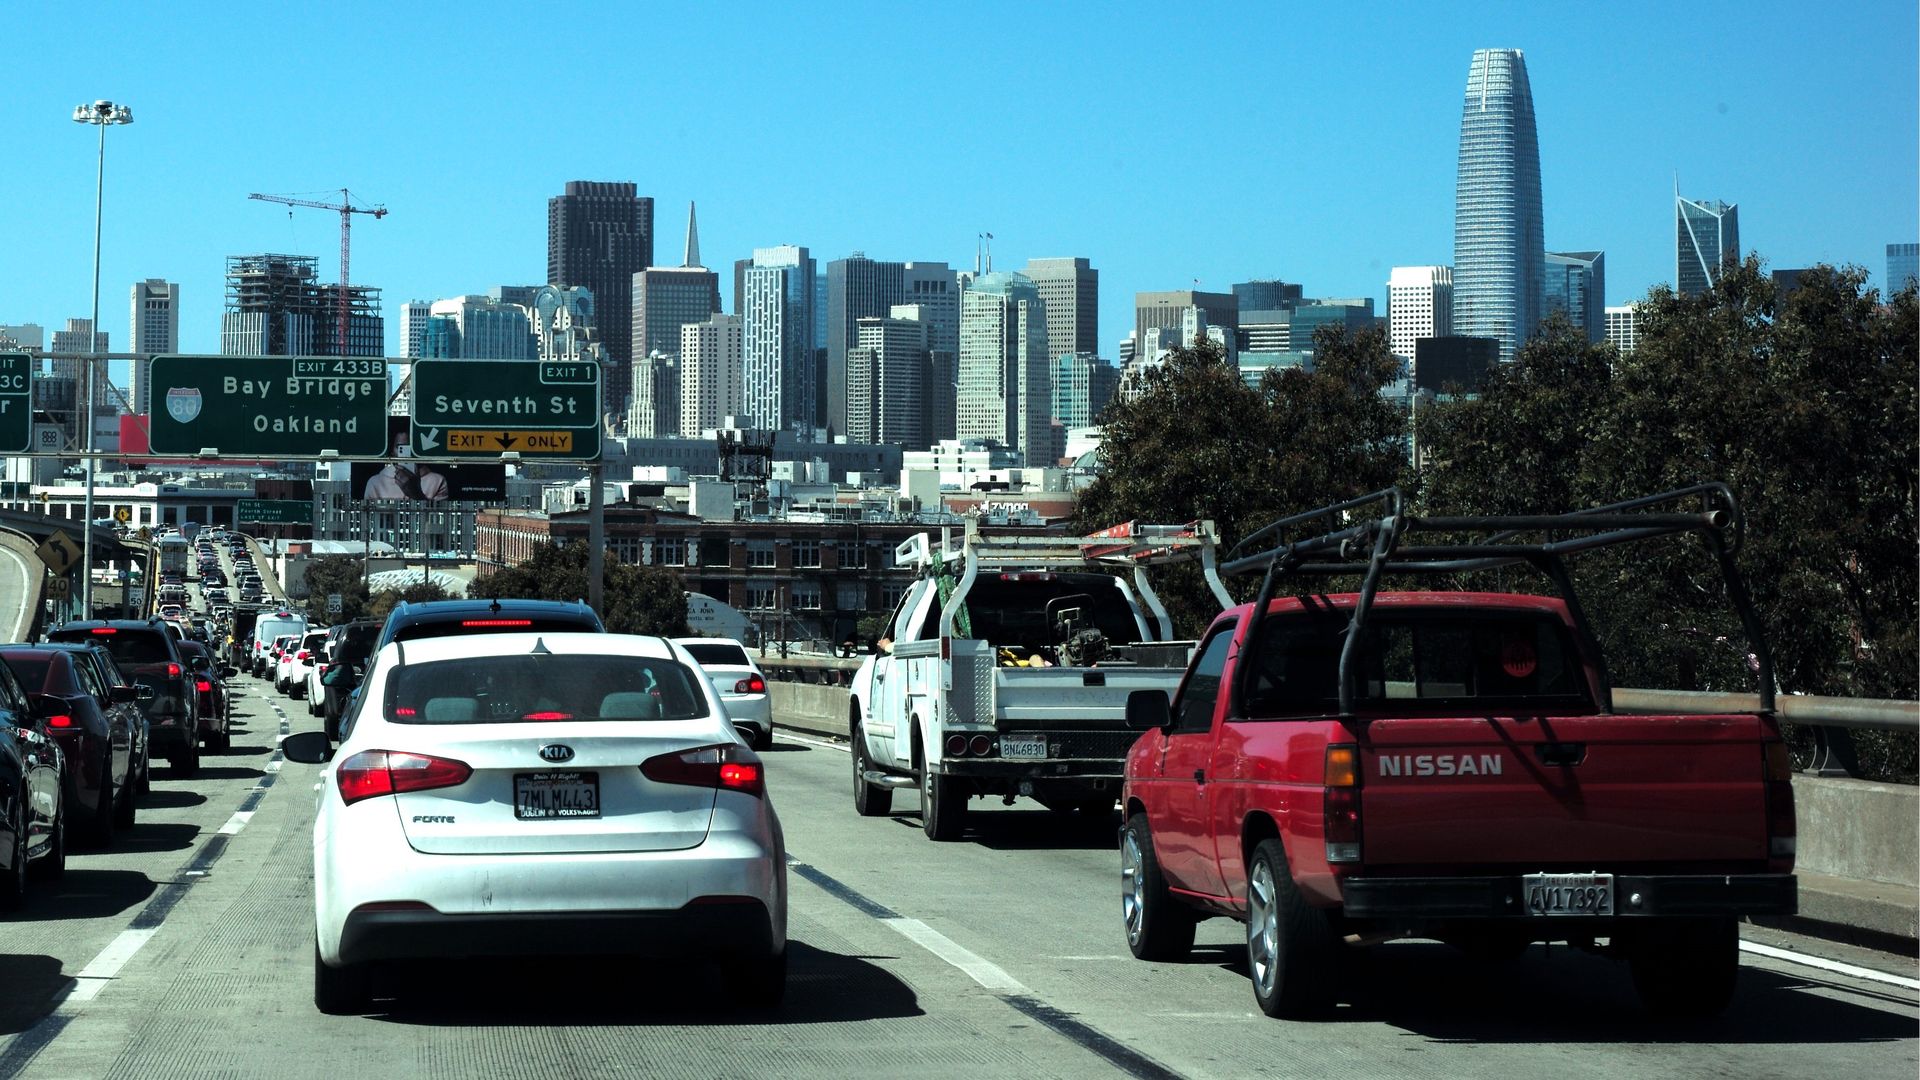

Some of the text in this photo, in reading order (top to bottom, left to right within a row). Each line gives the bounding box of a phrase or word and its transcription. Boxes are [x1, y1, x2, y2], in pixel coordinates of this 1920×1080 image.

[2, 359, 15, 369] IT
[298, 361, 383, 374] EXIT 433B
[546, 366, 591, 379] EXIT 1
[223, 376, 372, 401] Bay Bridge
[172, 400, 197, 416] 80
[435, 395, 577, 414] Seventh St
[253, 415, 357, 433] Oakland
[450, 434, 568, 448] EXIT ONLY
[48, 580, 67, 592] 40
[329, 604, 341, 612] 50
[544, 746, 568, 758] KIA
[1003, 743, 1045, 757] 8N46830
[1379, 754, 1502, 776] NISSAN
[519, 788, 594, 809] 7MLM443
[412, 815, 455, 824] FORTE
